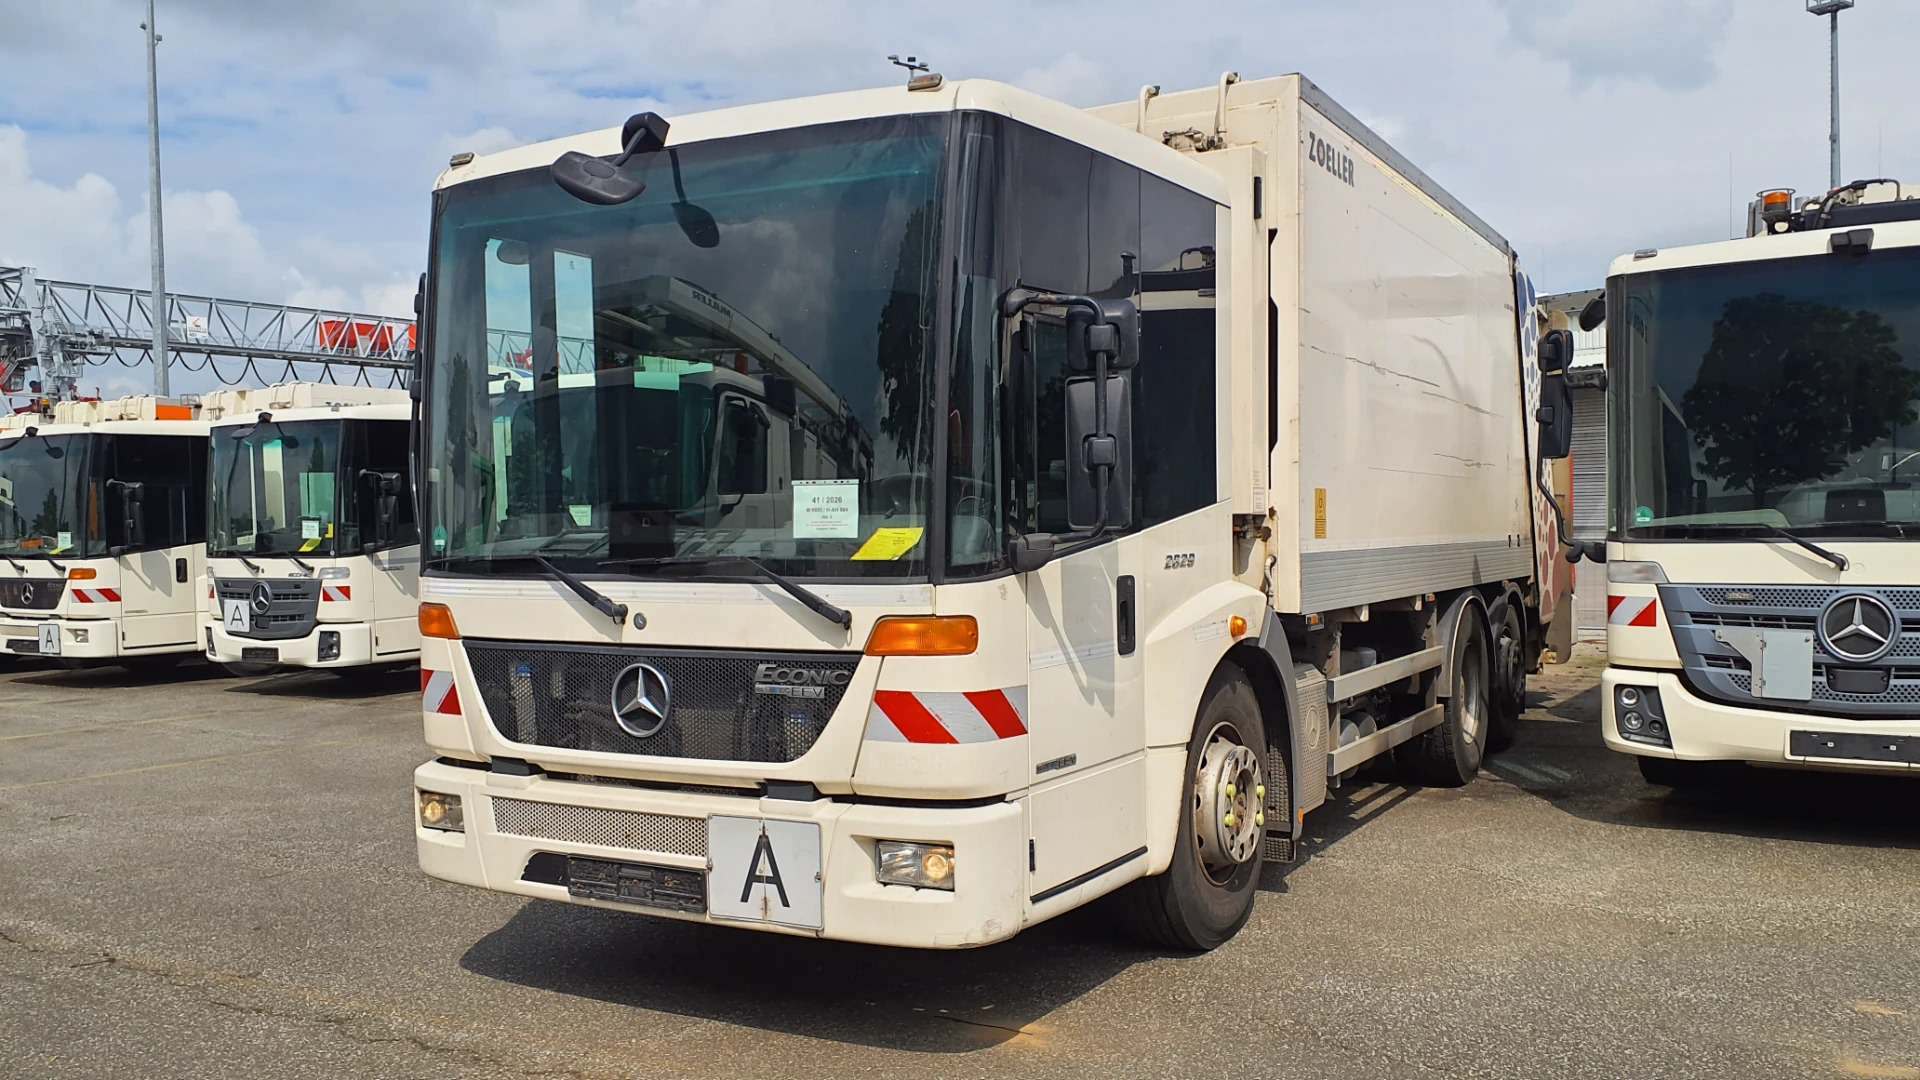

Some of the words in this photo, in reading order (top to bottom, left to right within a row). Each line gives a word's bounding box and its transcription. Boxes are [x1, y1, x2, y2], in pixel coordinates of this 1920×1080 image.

[1309, 131, 1354, 187] ZOELLER
[230, 604, 245, 626] A
[45, 628, 55, 649] A
[791, 687, 824, 698] EEV
[740, 833, 791, 908] A
